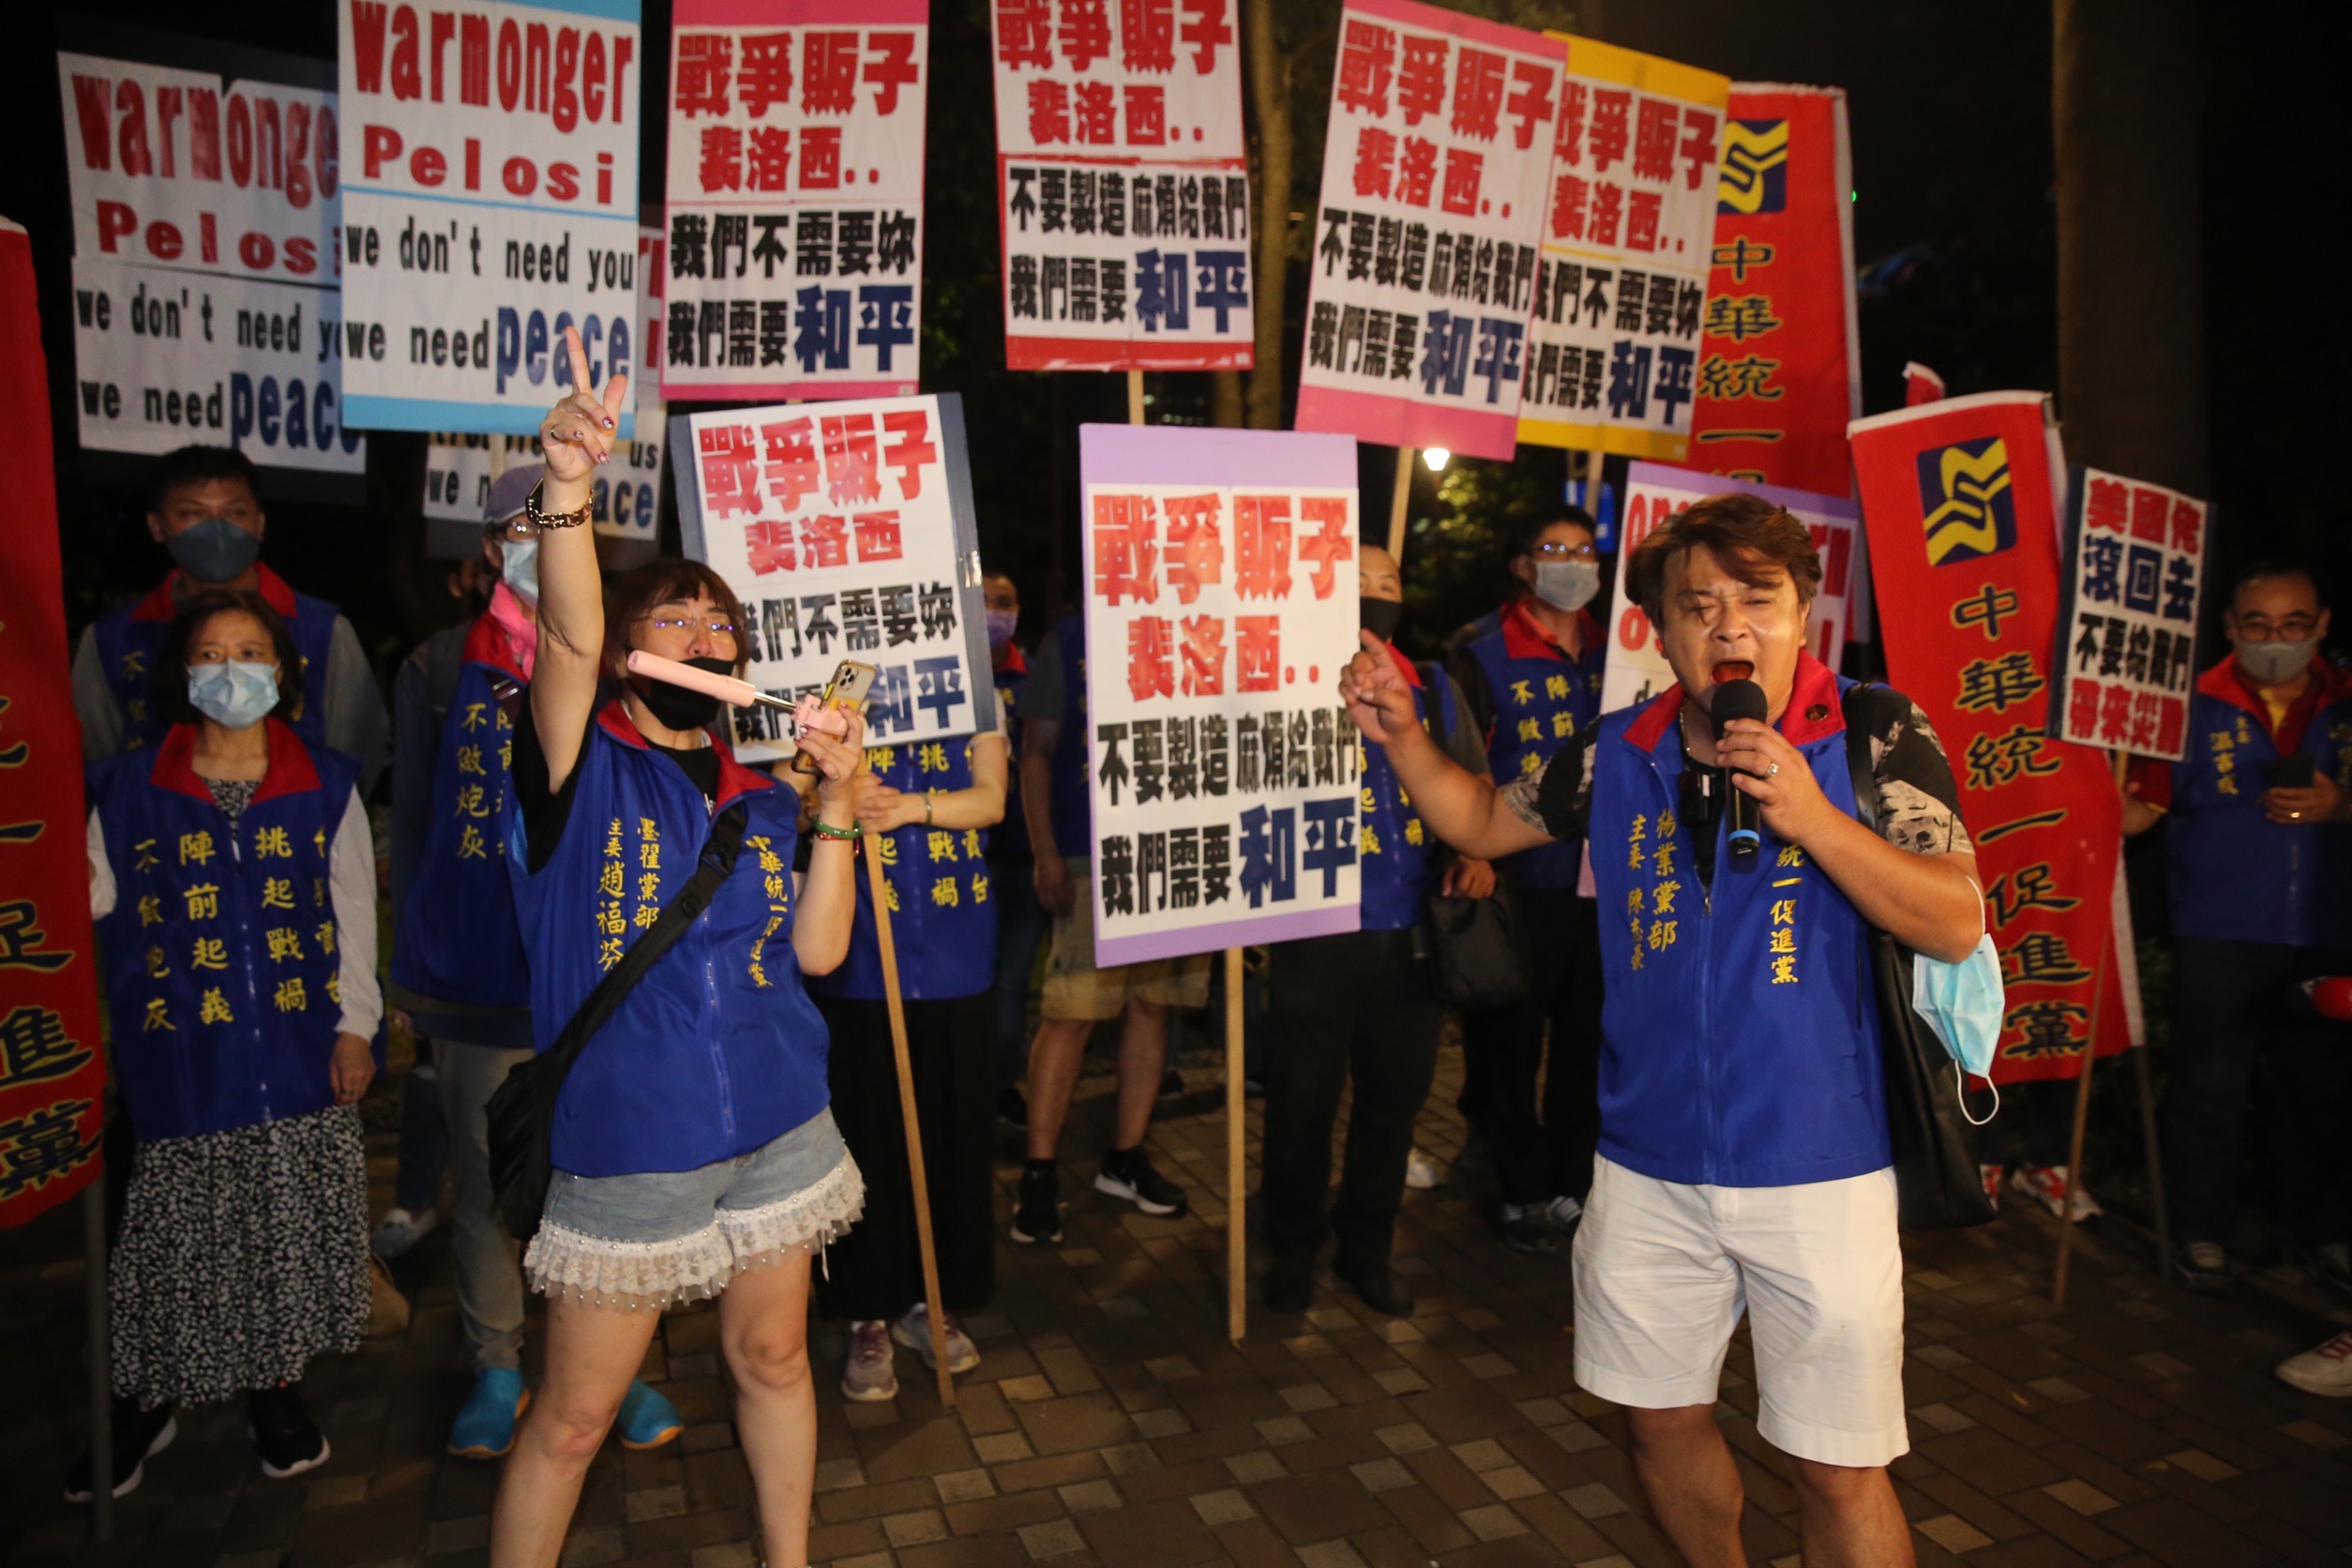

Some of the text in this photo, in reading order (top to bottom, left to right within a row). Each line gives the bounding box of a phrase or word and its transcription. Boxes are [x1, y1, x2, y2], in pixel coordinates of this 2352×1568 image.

[675, 31, 919, 119] 戰爭販子
[996, 0, 1232, 76] 戰爭販子
[1337, 19, 1555, 151] 戰爭販子
[364, 124, 613, 204] Pelosi
[346, 224, 380, 266] we
[506, 232, 569, 283] need
[587, 248, 635, 292] you
[671, 209, 916, 279] 我們不需要妳
[77, 288, 111, 330] we
[237, 302, 301, 353] need
[668, 285, 914, 373] 我們需要和平
[1010, 248, 1248, 333] 我們需要和平
[346, 307, 630, 394] we need peace
[1310, 300, 1524, 403] 我們需要和平
[1697, 236, 1786, 483] 中華統一
[81, 381, 121, 419] we
[144, 382, 223, 429] need
[699, 411, 936, 519] 戰爭販子
[745, 511, 902, 576] 裴洛西
[1093, 493, 1353, 608] 戰爭販子
[2083, 535, 2194, 622] 滾回去
[1100, 797, 1357, 919] 我們需要和平
[178, 829, 234, 1025] 陣前起義
[254, 825, 307, 1012] 挑起戰禍
